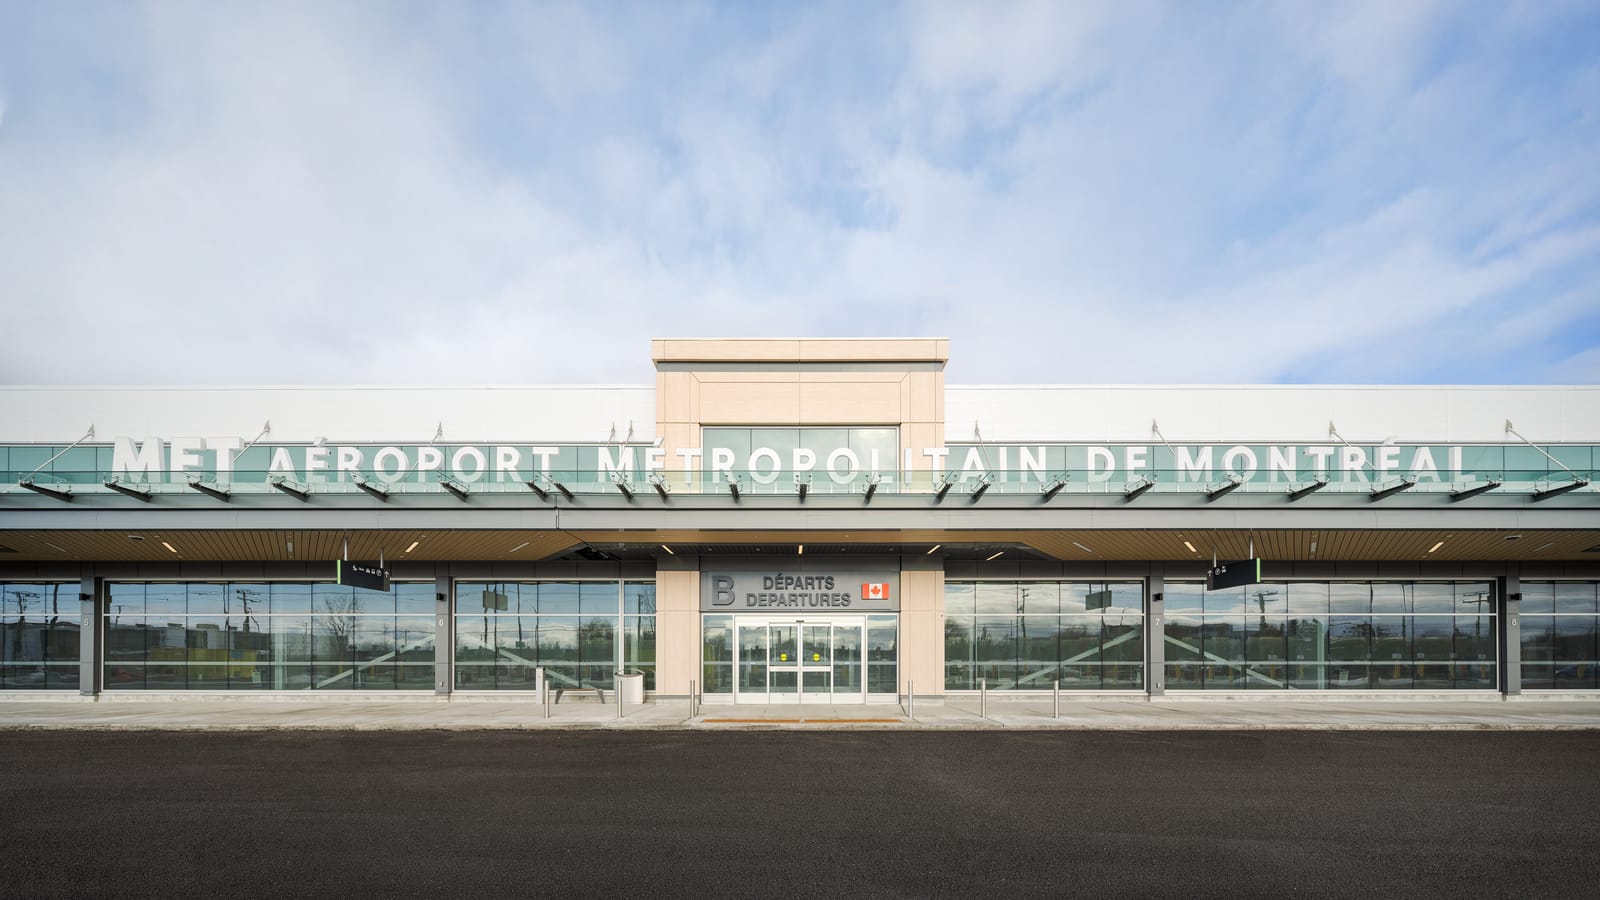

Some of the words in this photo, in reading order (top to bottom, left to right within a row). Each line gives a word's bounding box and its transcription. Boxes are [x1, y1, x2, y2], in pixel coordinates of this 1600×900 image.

[111, 437, 246, 484] MET
[264, 437, 560, 483] AÉROPORT
[597, 438, 1048, 483] MÉTROPOLITAIN
[1086, 446, 1148, 483] DE
[1175, 436, 1477, 483] MONTRÉAL
[712, 575, 735, 606] B
[763, 573, 835, 590] DÉPARTS
[746, 593, 851, 607] DEPARTURES
